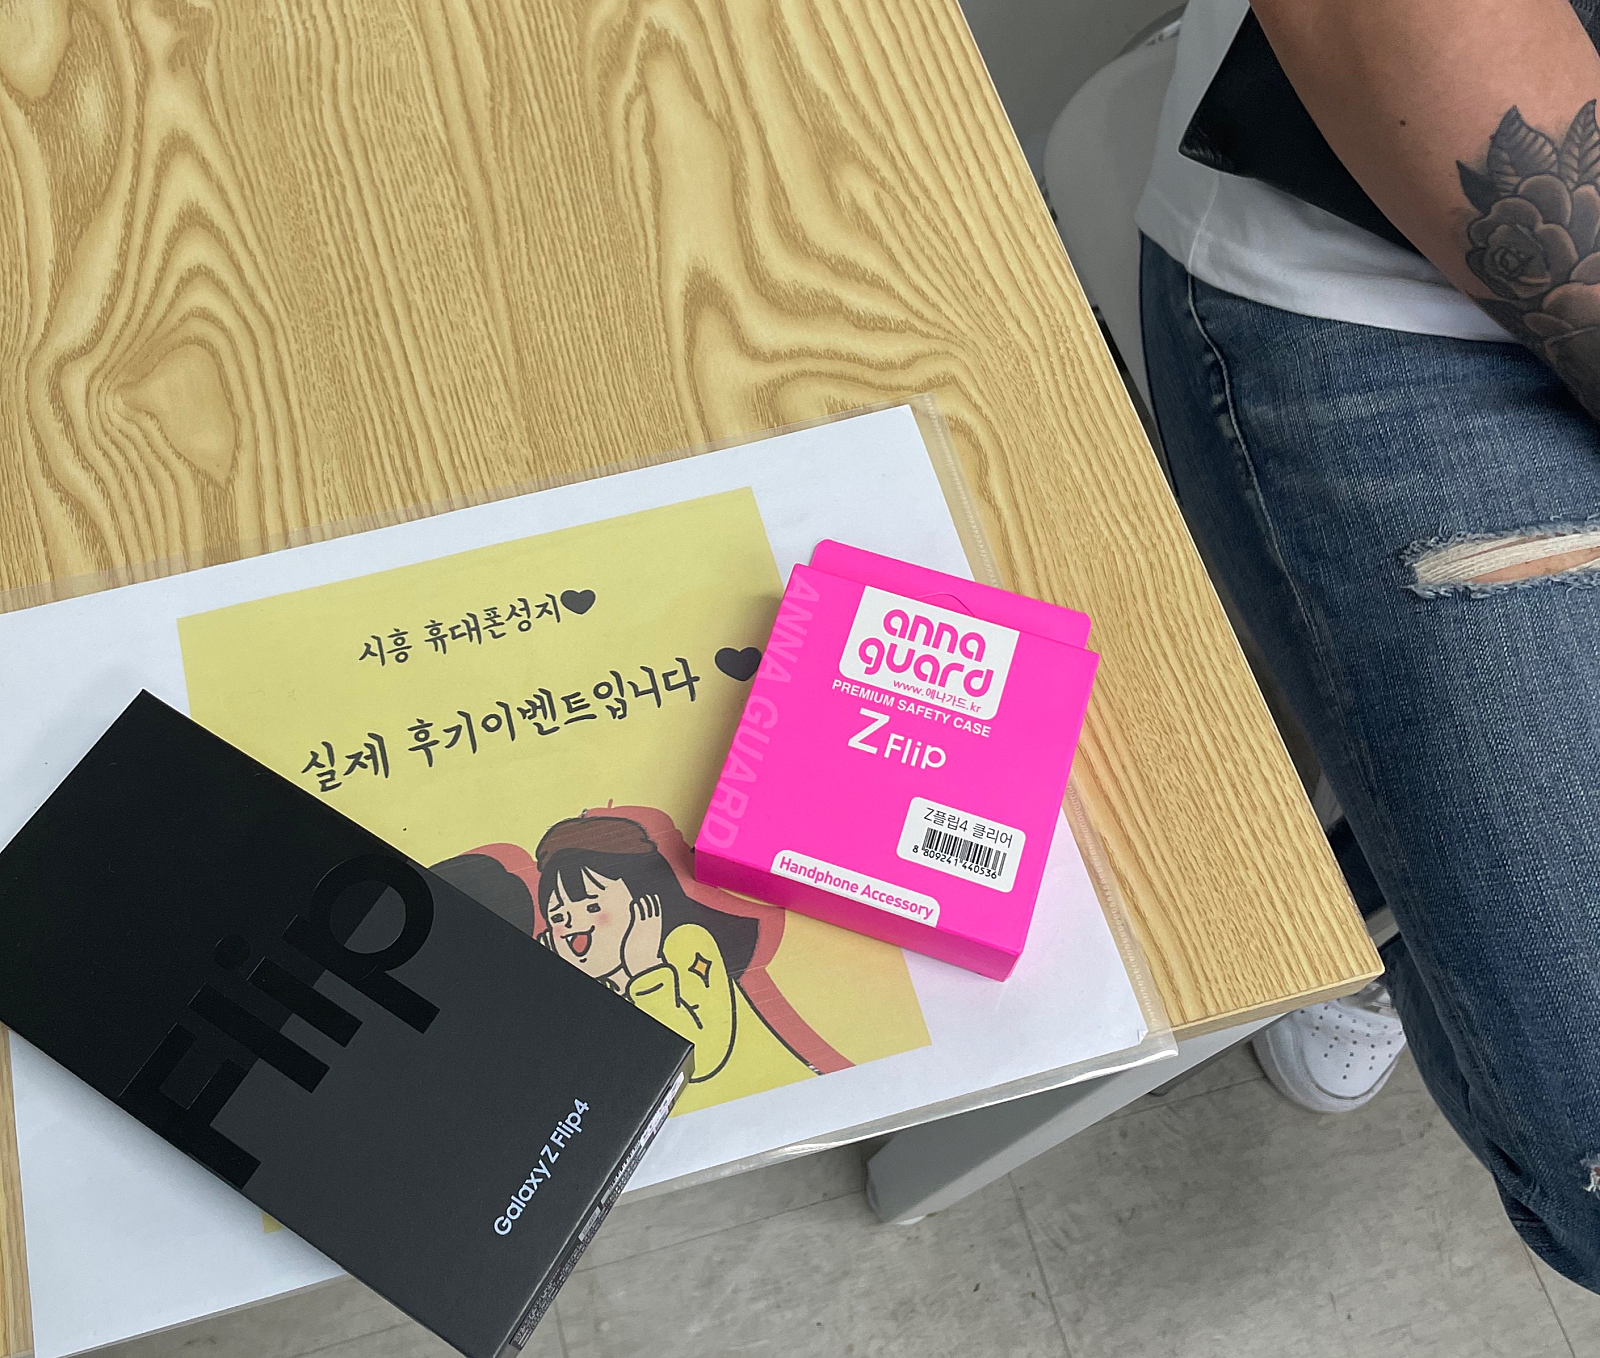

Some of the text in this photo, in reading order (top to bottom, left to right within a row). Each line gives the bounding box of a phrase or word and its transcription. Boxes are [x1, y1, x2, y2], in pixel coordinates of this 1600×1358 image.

[358, 593, 560, 666] 시흥 휴대폰성지
[883, 609, 986, 662] anna
[858, 637, 994, 697] guard
[700, 573, 820, 849] ANNA GUARD
[832, 679, 992, 738] PREMIUM SAFETY CASE
[848, 707, 947, 770] Z Flip
[301, 731, 389, 792] 실제
[923, 807, 1013, 848] Z플립4 클리어
[779, 856, 934, 920] Handphone Accessory
[118, 853, 441, 1190] Flip
[493, 1159, 552, 1236] Galaxy
[540, 1144, 560, 1164] Z
[550, 1098, 590, 1149] Flip4
